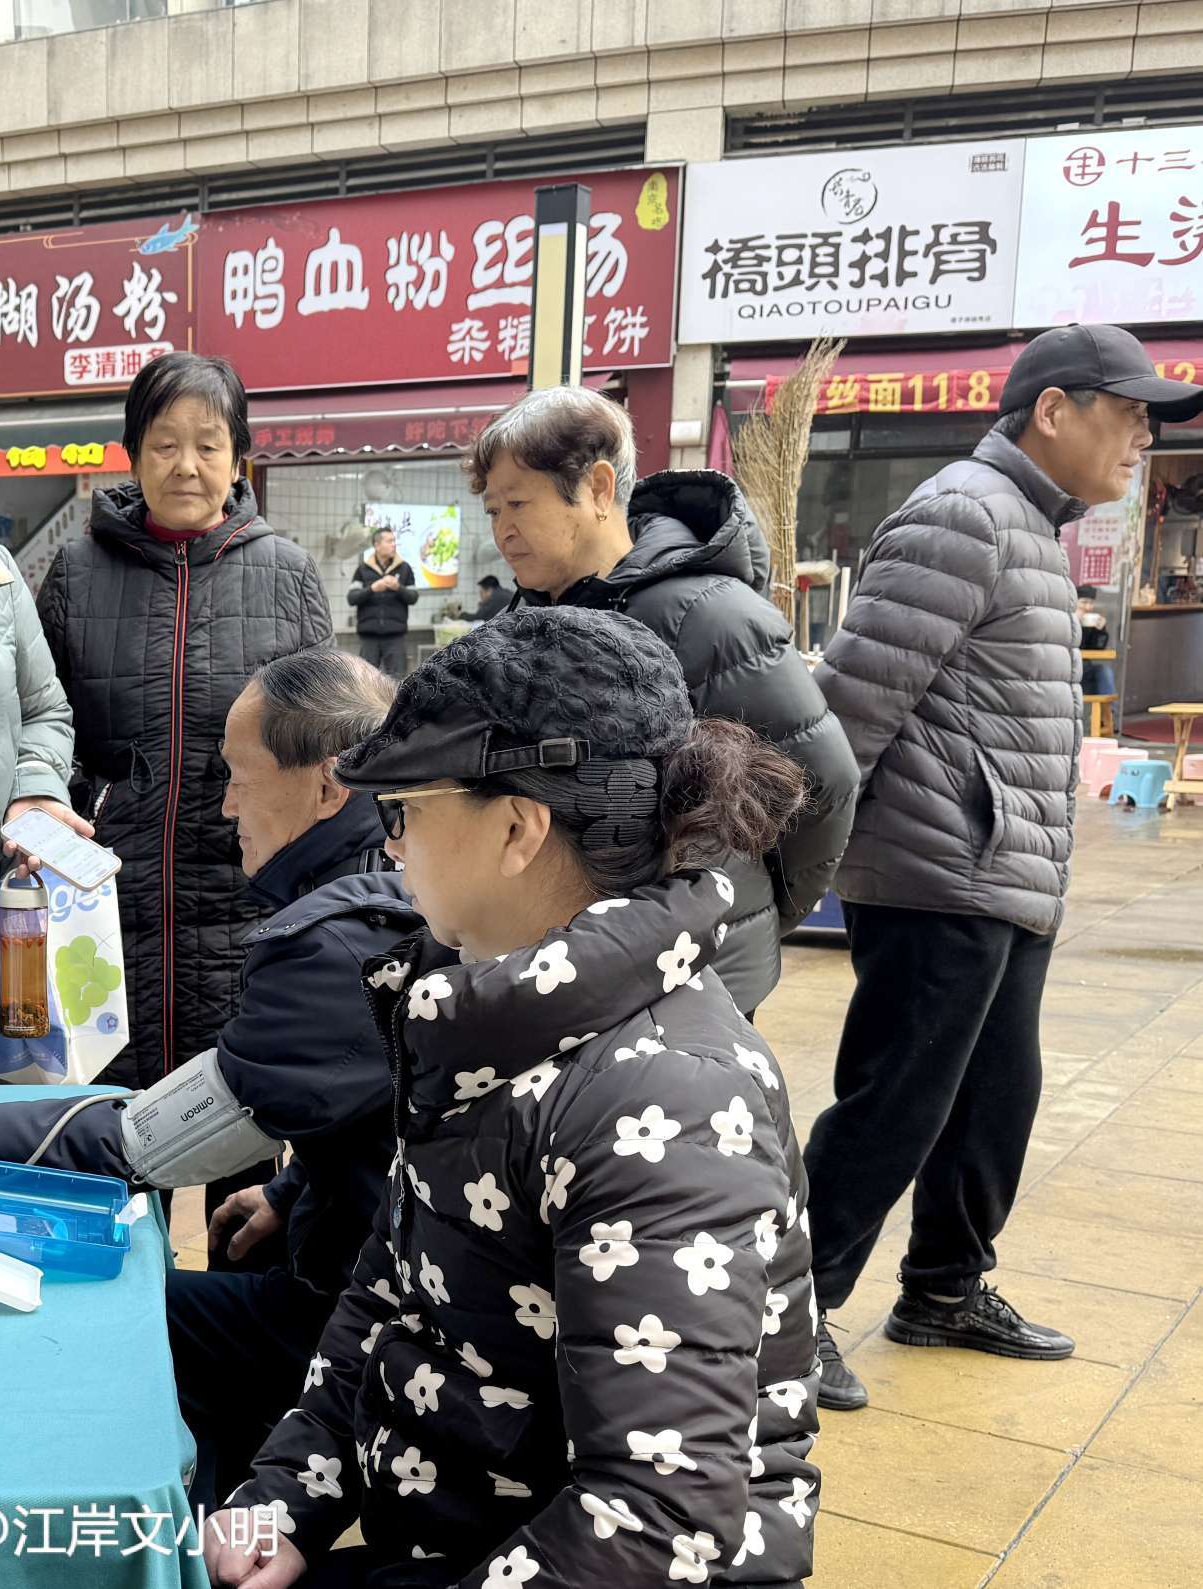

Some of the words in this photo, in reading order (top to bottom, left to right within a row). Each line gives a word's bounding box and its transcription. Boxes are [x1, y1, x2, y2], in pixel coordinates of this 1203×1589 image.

[737, 293, 953, 319] QIAOTOUPAIGU
[446, 305, 651, 366] 杂粮饼
[812, 370, 991, 414] 丝面11.8
[180, 1096, 214, 1122] OMRON
